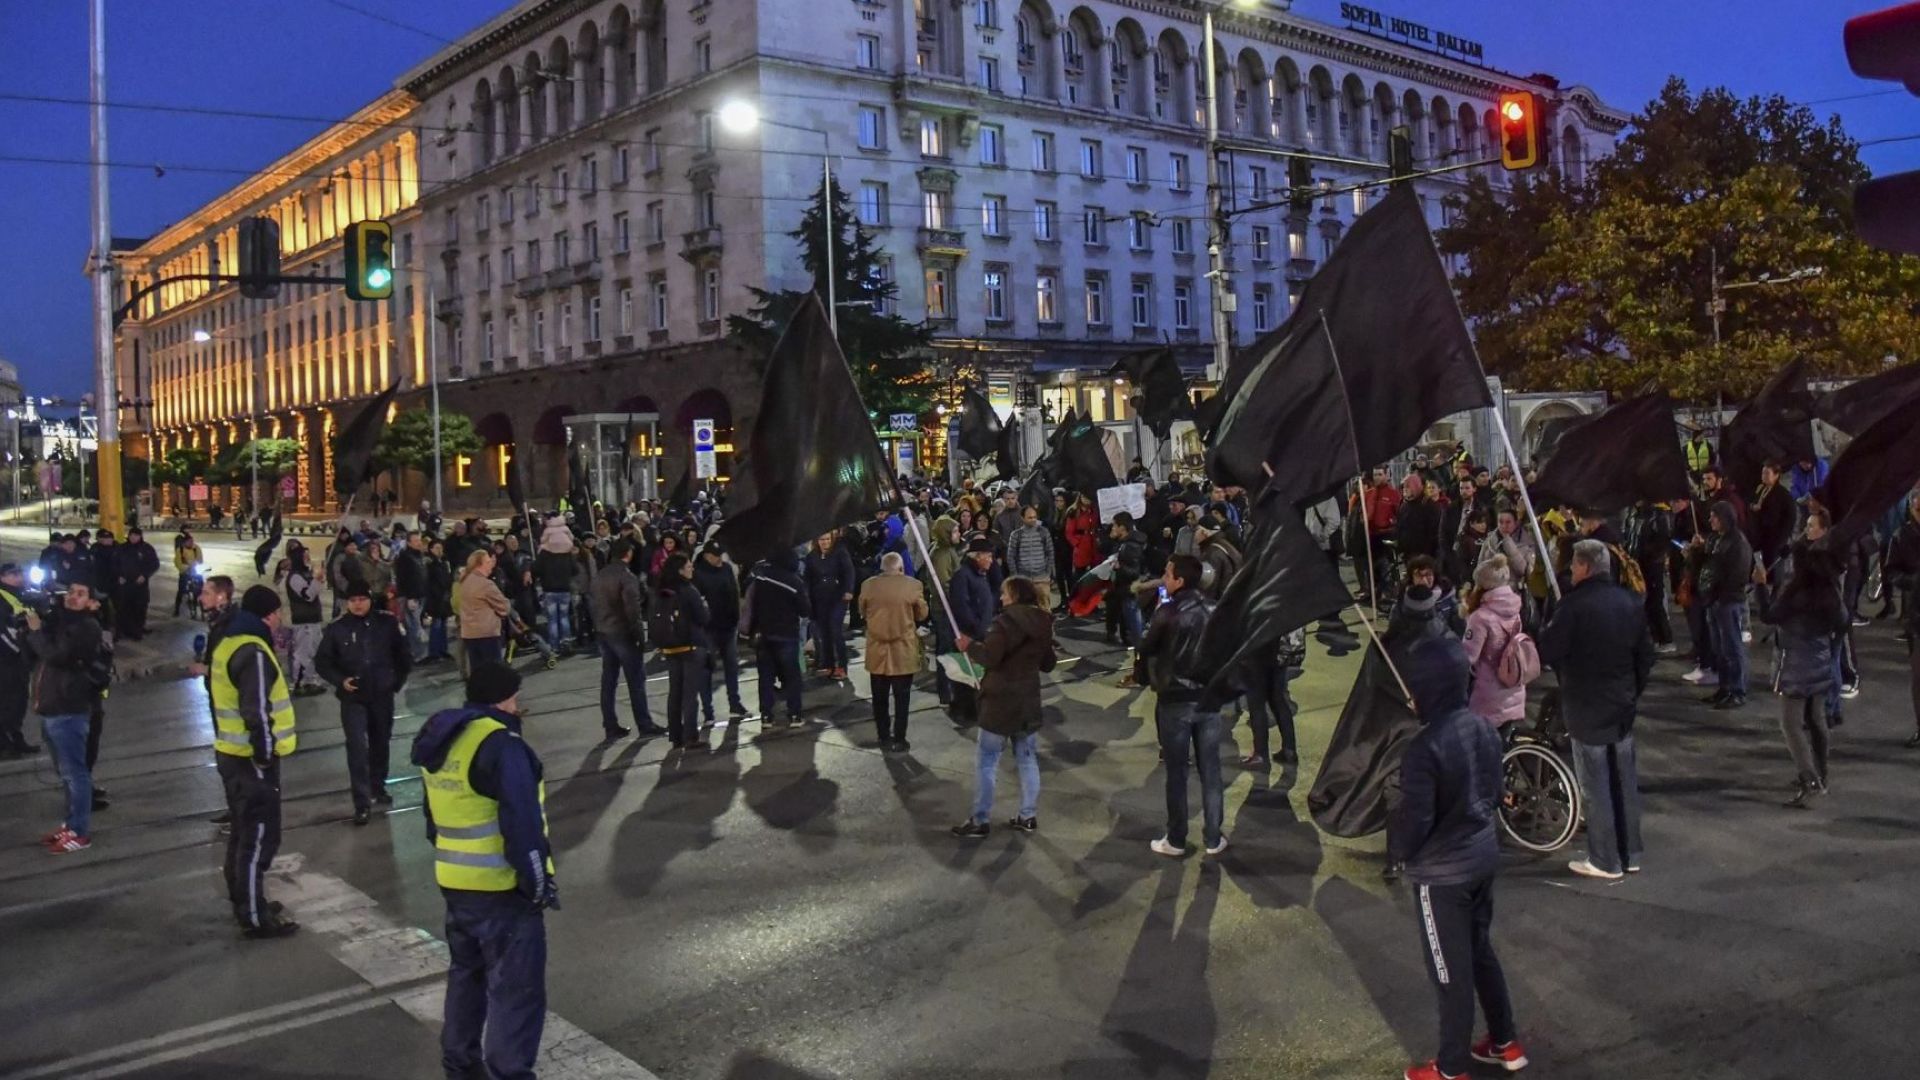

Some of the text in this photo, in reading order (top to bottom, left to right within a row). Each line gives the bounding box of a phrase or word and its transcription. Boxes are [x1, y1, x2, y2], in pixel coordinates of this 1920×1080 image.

[1340, 2, 1482, 58] SOFIA HOTEL BALKAN
